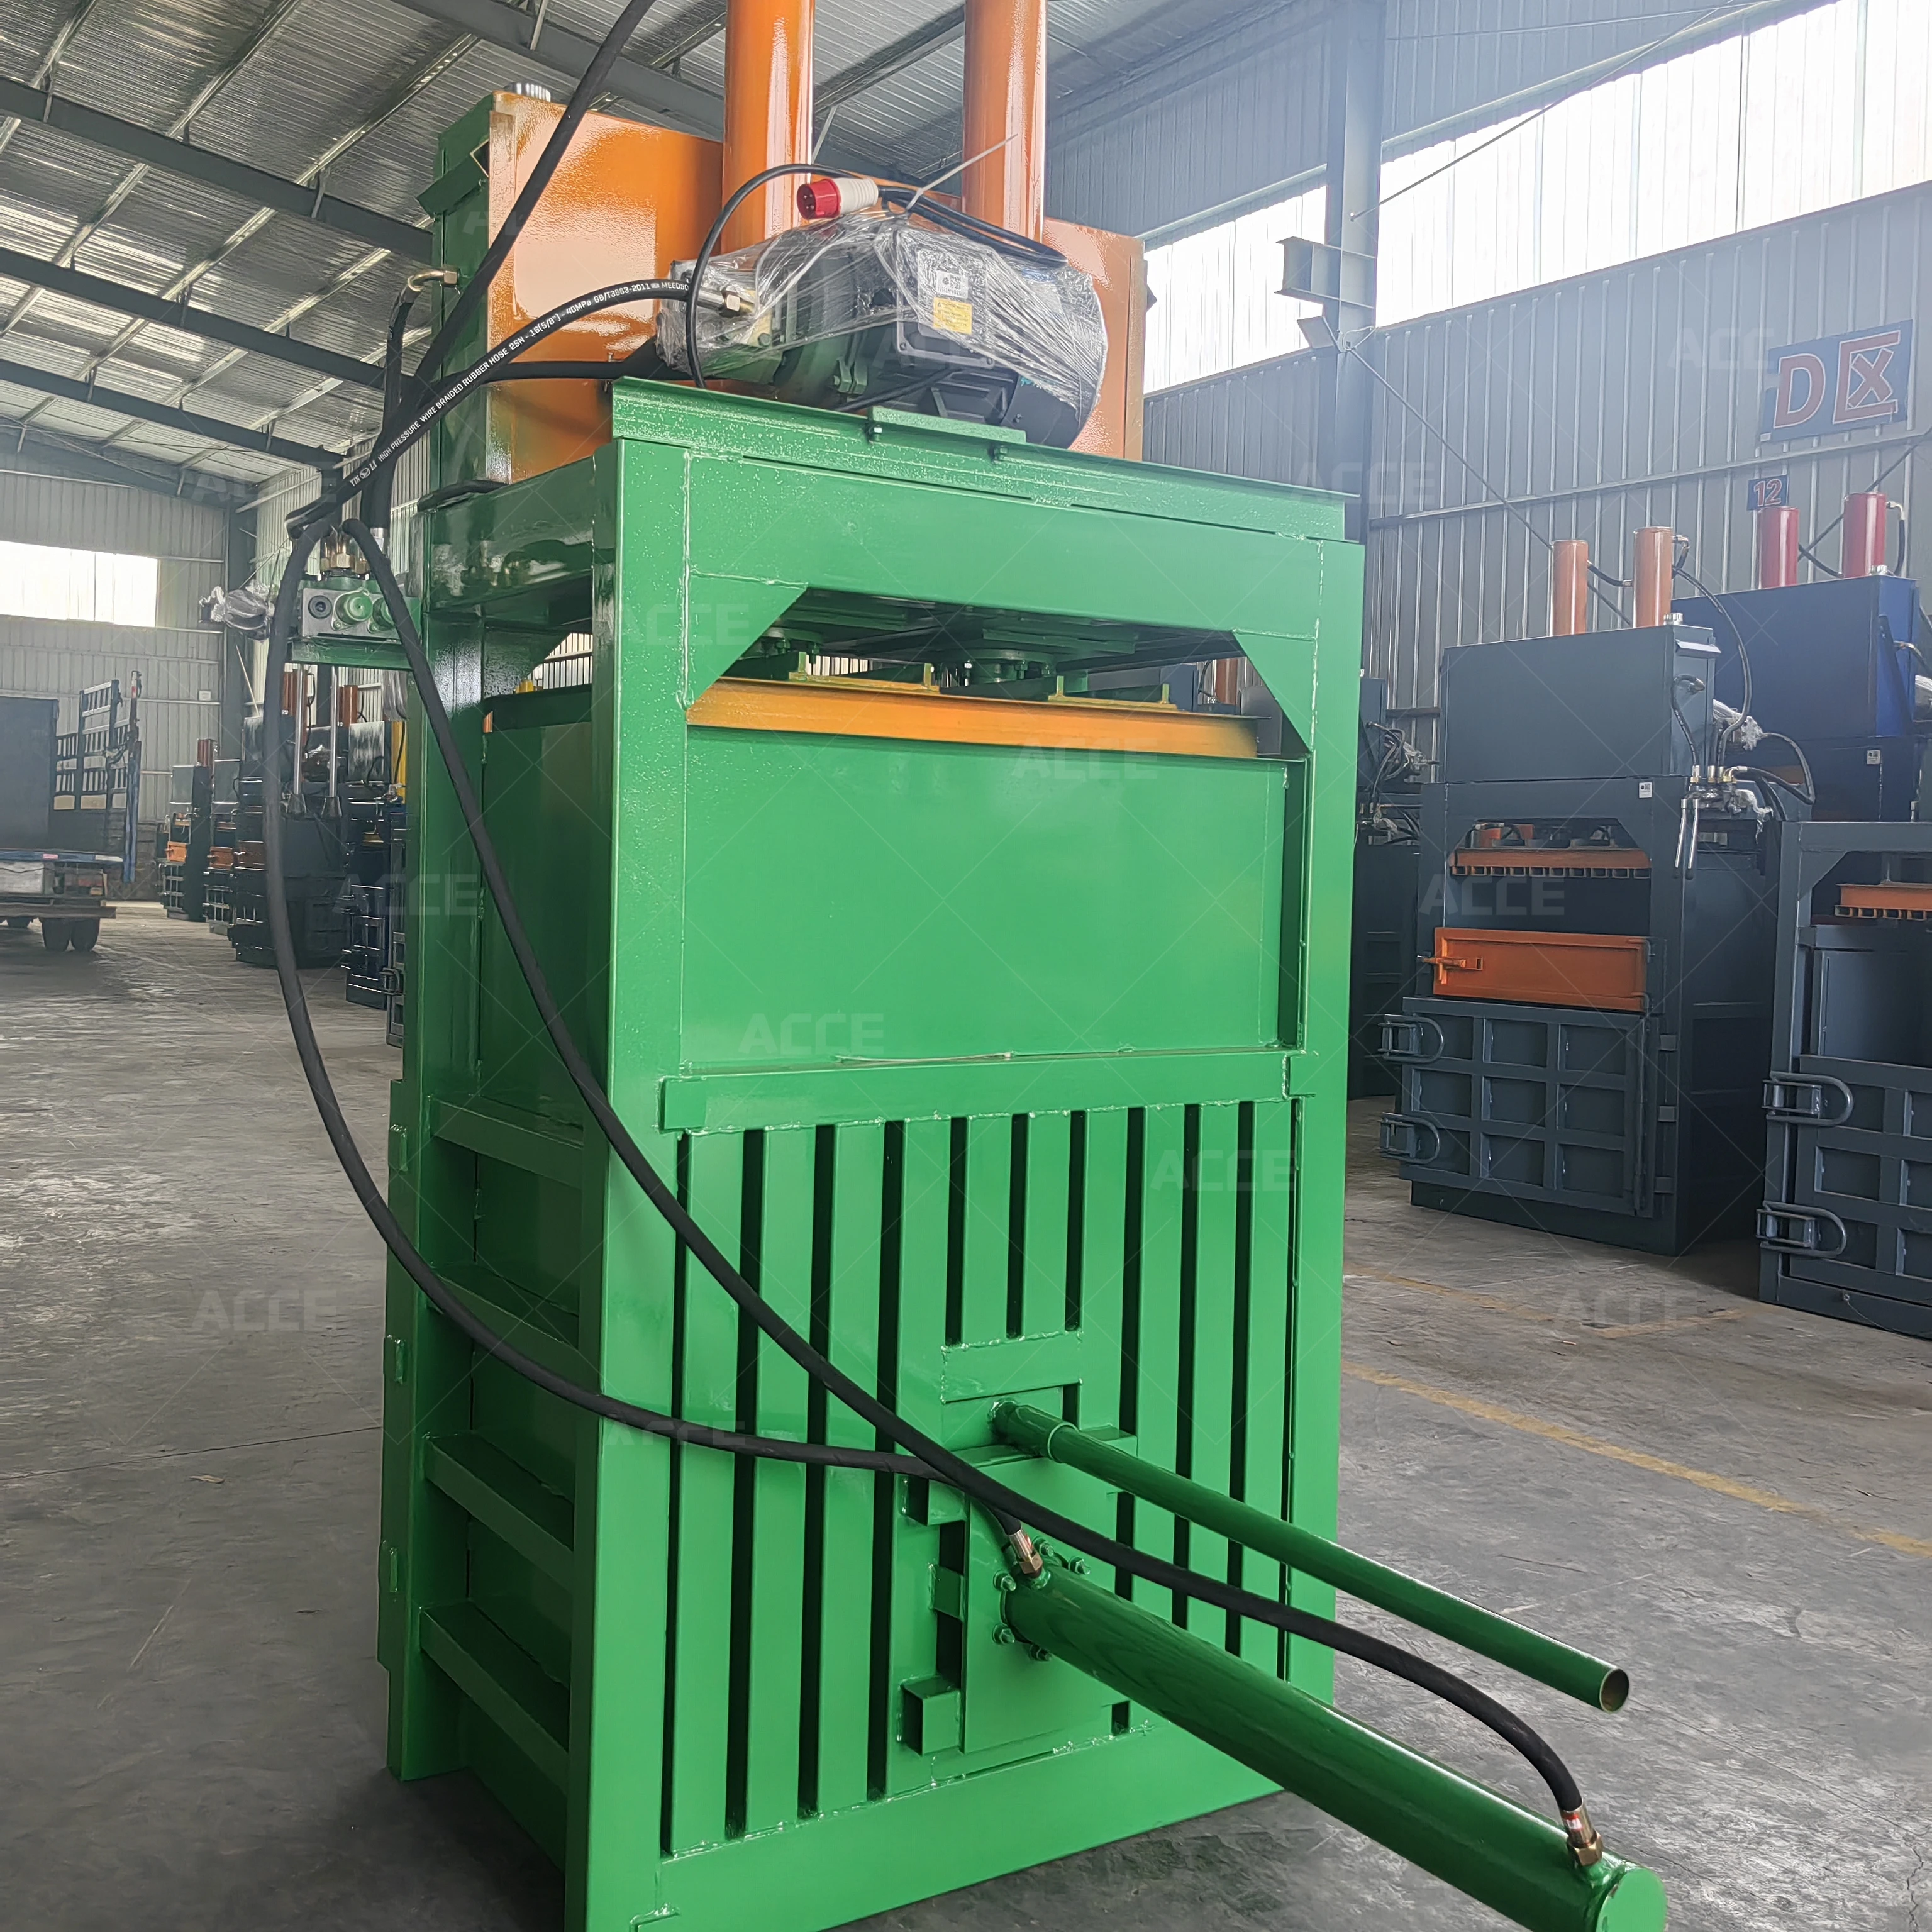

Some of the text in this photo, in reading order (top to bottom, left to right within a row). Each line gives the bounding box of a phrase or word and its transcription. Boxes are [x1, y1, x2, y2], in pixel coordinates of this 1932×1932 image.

[377, 447, 392, 462] HIGH
[391, 421, 421, 450] PRESSURE
[419, 406, 438, 423] WIRE
[435, 383, 464, 409] BRAIDED
[462, 362, 491, 387] RUBBER
[488, 348, 509, 365] HOSE
[509, 336, 525, 350] 2SN
[1753, 479, 1782, 506] 12
